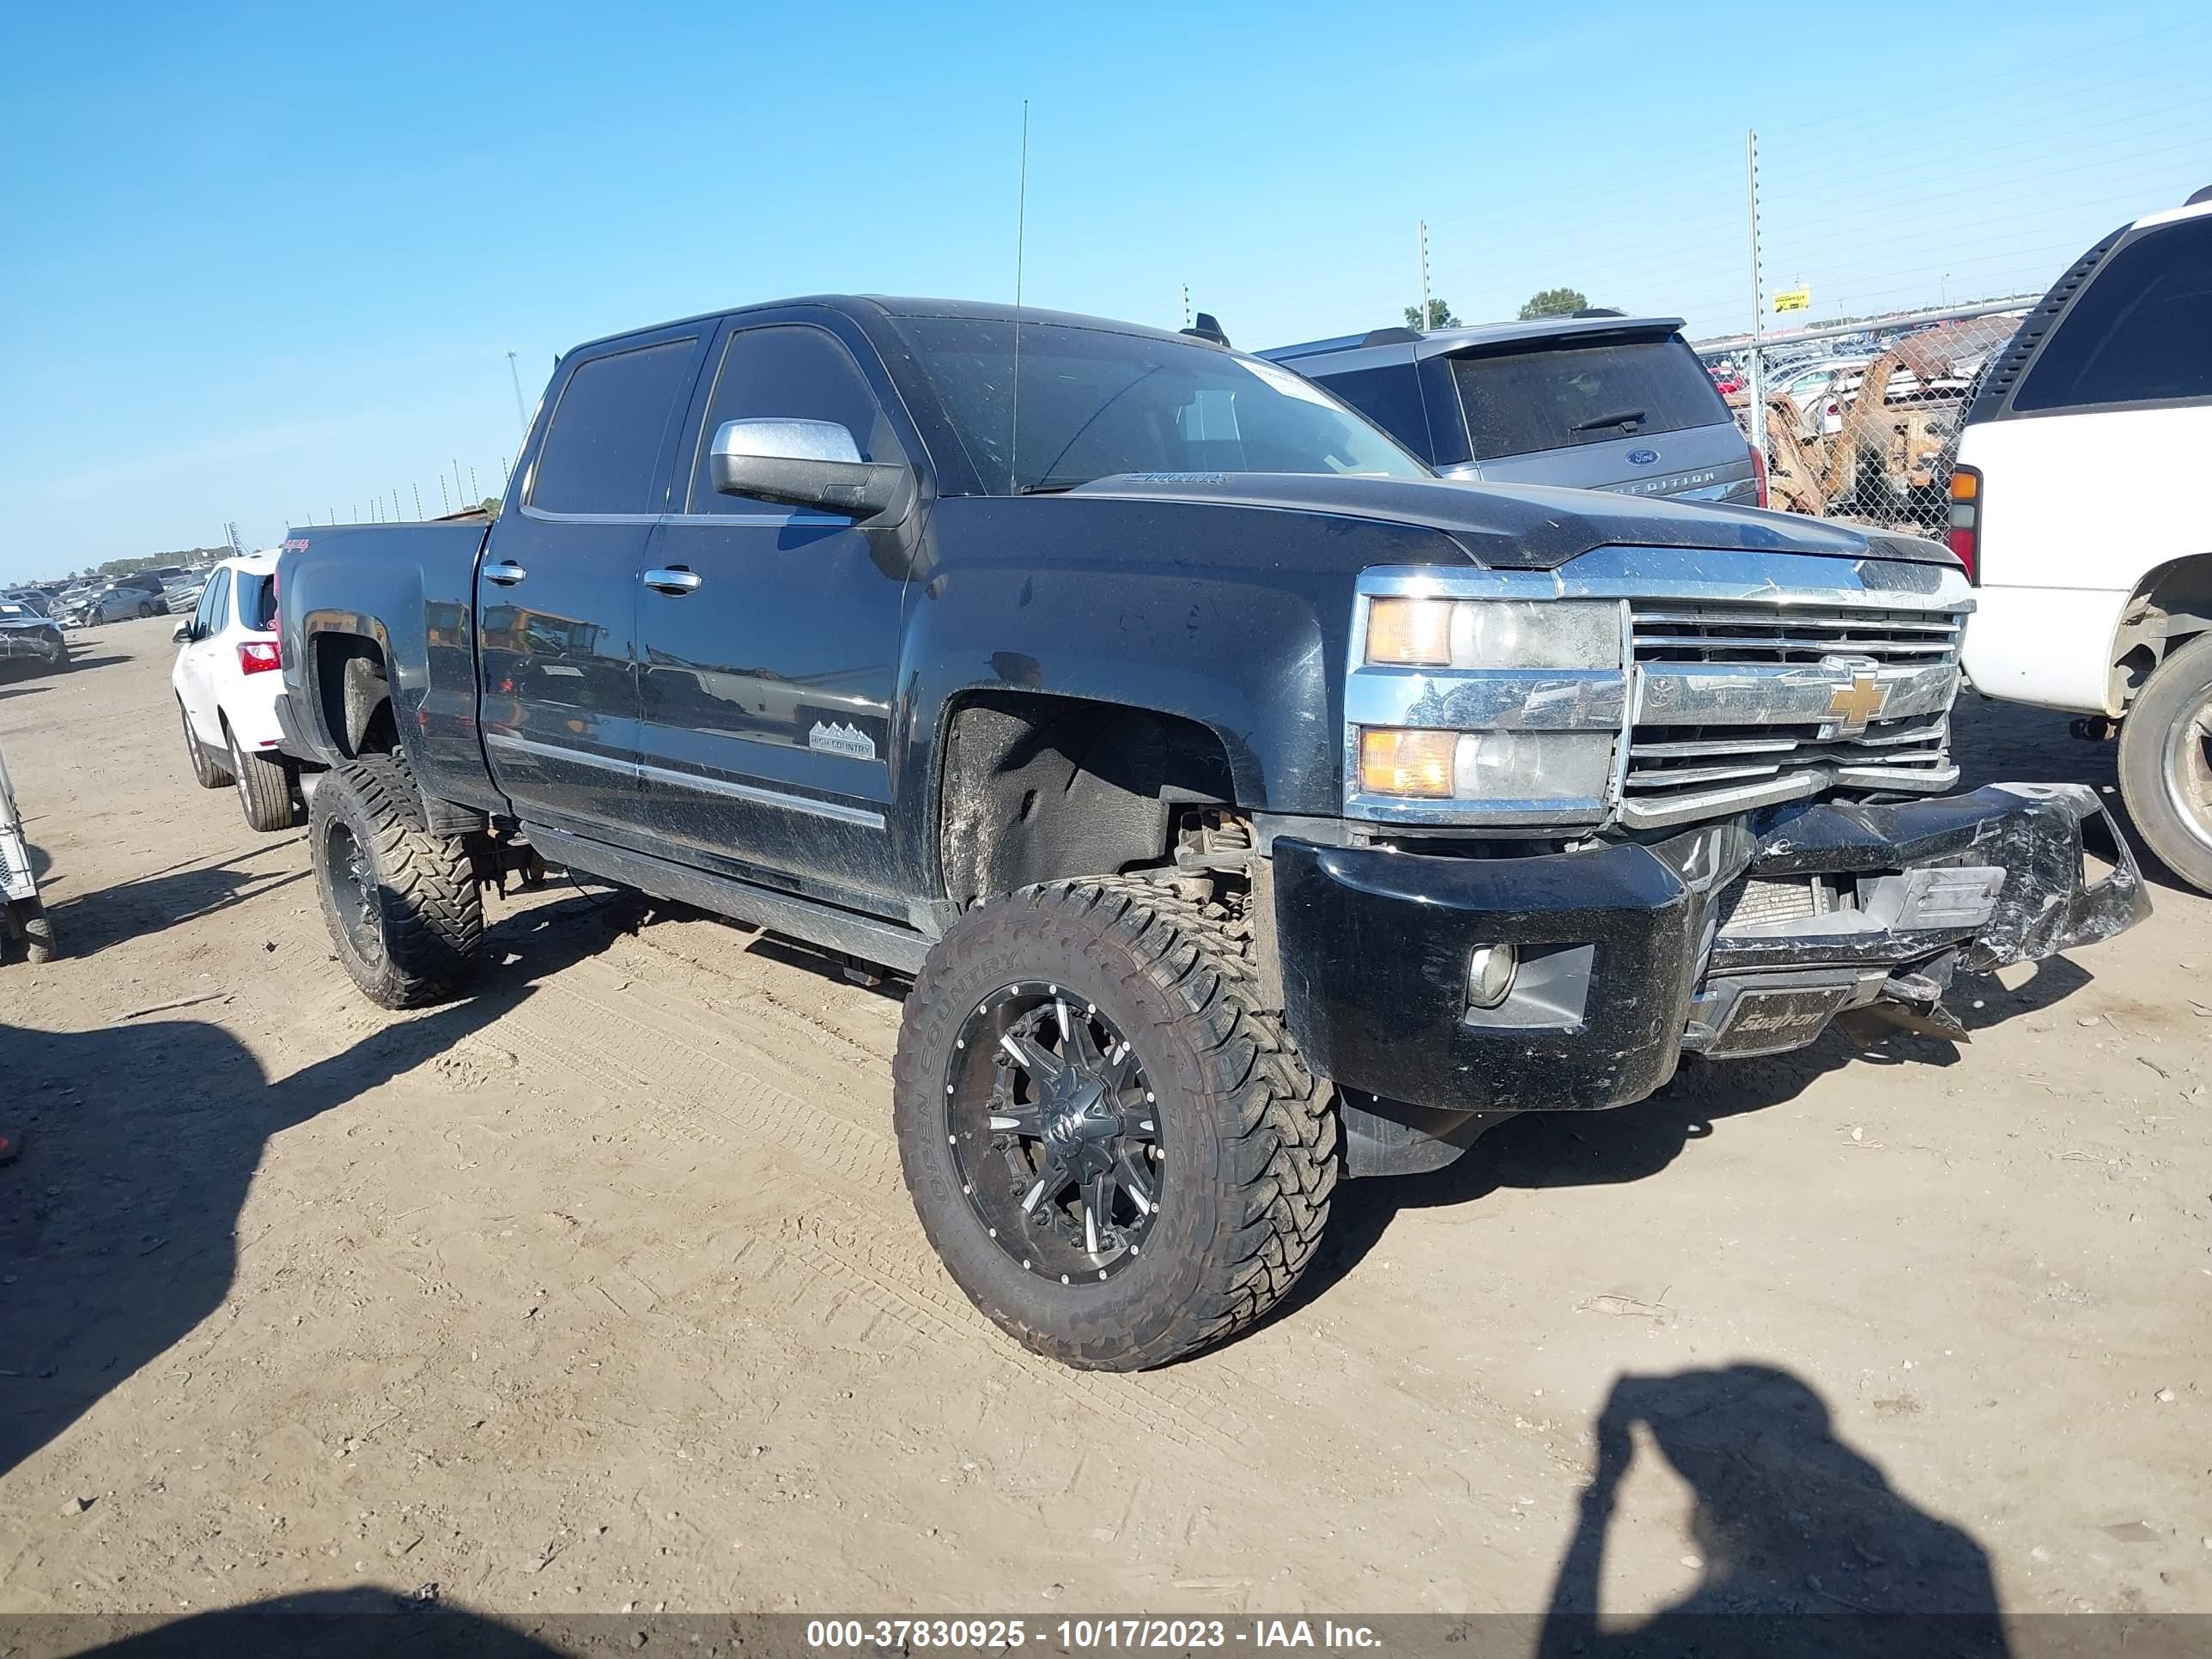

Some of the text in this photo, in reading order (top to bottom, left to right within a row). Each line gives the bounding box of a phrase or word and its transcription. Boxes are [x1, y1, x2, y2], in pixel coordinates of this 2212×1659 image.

[1634, 452, 1654, 463] Ford
[811, 736, 871, 754] HIGH COUNTRY
[916, 1091, 951, 1203] OPEN
